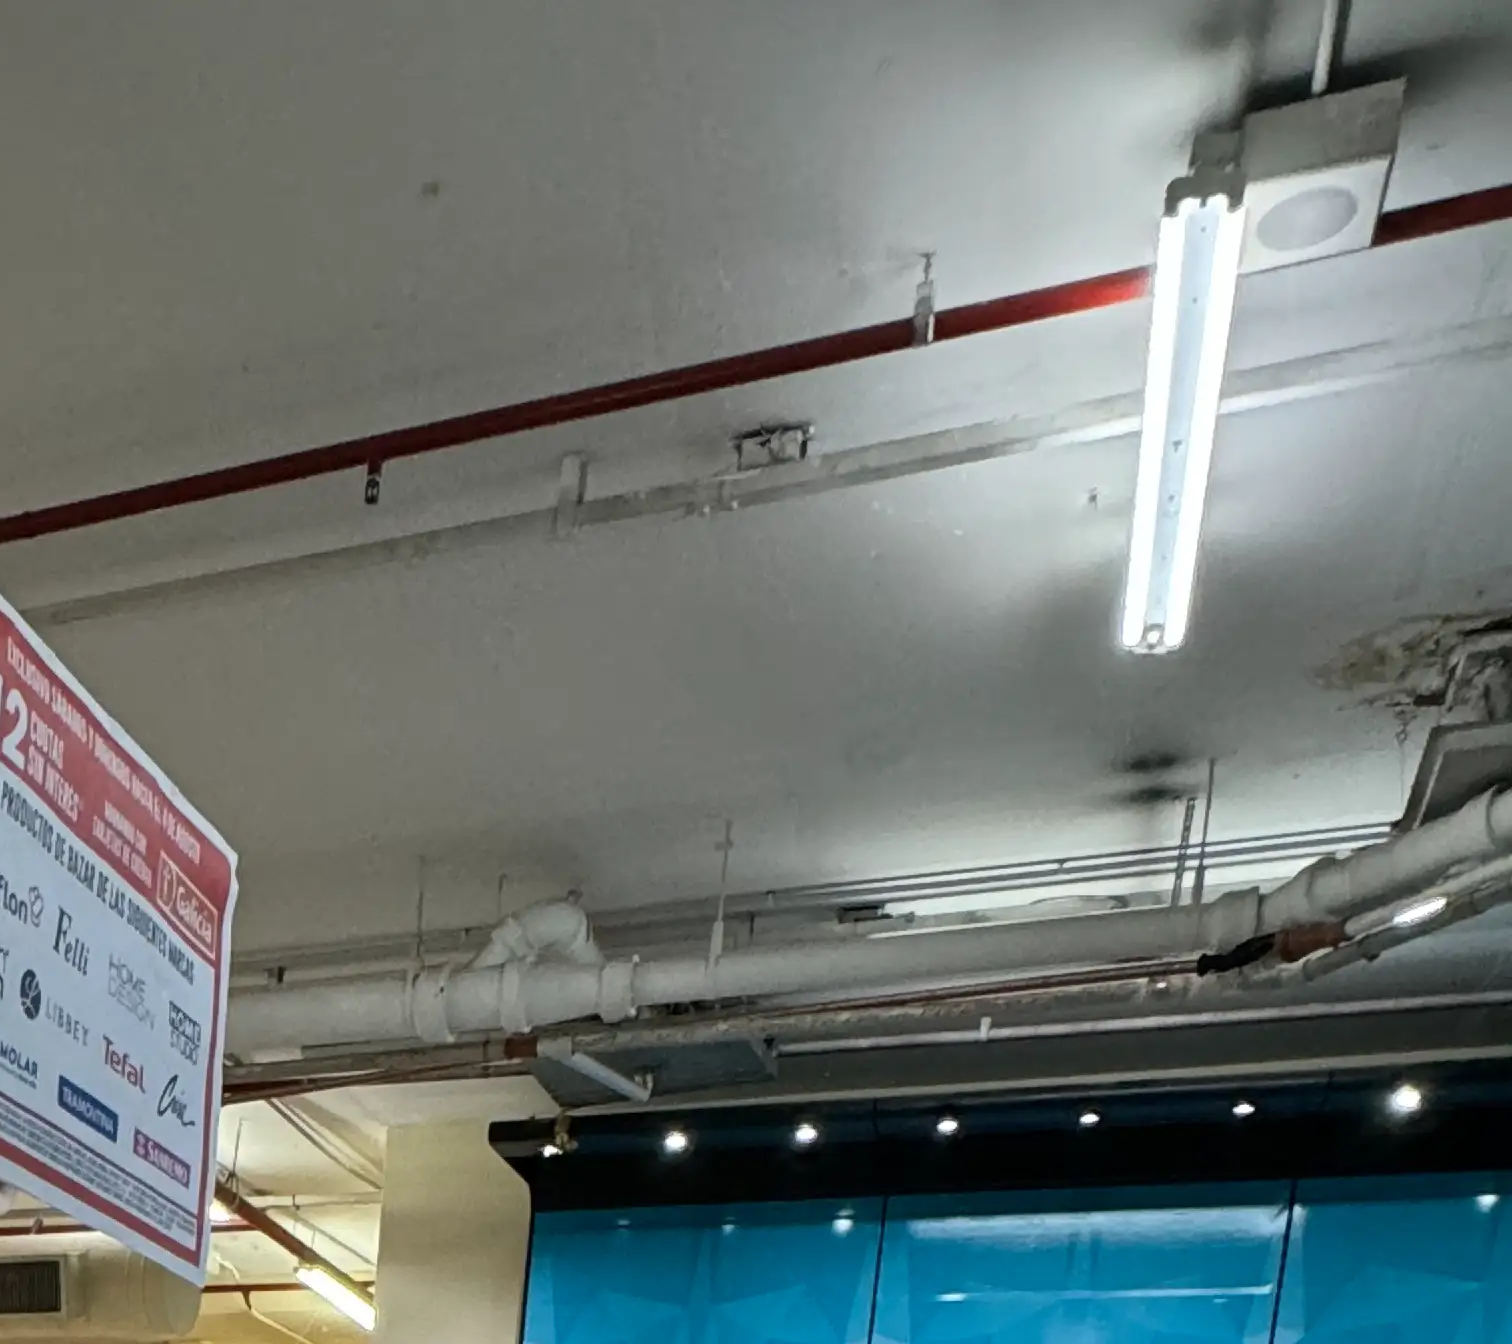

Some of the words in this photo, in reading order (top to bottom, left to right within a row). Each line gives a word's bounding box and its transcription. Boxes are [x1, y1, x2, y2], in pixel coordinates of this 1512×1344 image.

[27, 745, 45, 786] SIN
[30, 710, 64, 770] CUOTAS
[0, 780, 54, 854] PRODUCTOS
[54, 832, 66, 867] DE
[66, 845, 95, 892] BAZAR
[96, 871, 109, 904] DE
[109, 884, 125, 919] LAS
[53, 904, 90, 977] Felli
[45, 996, 90, 1048] LIBBEY
[102, 1033, 147, 1095] Tefal
